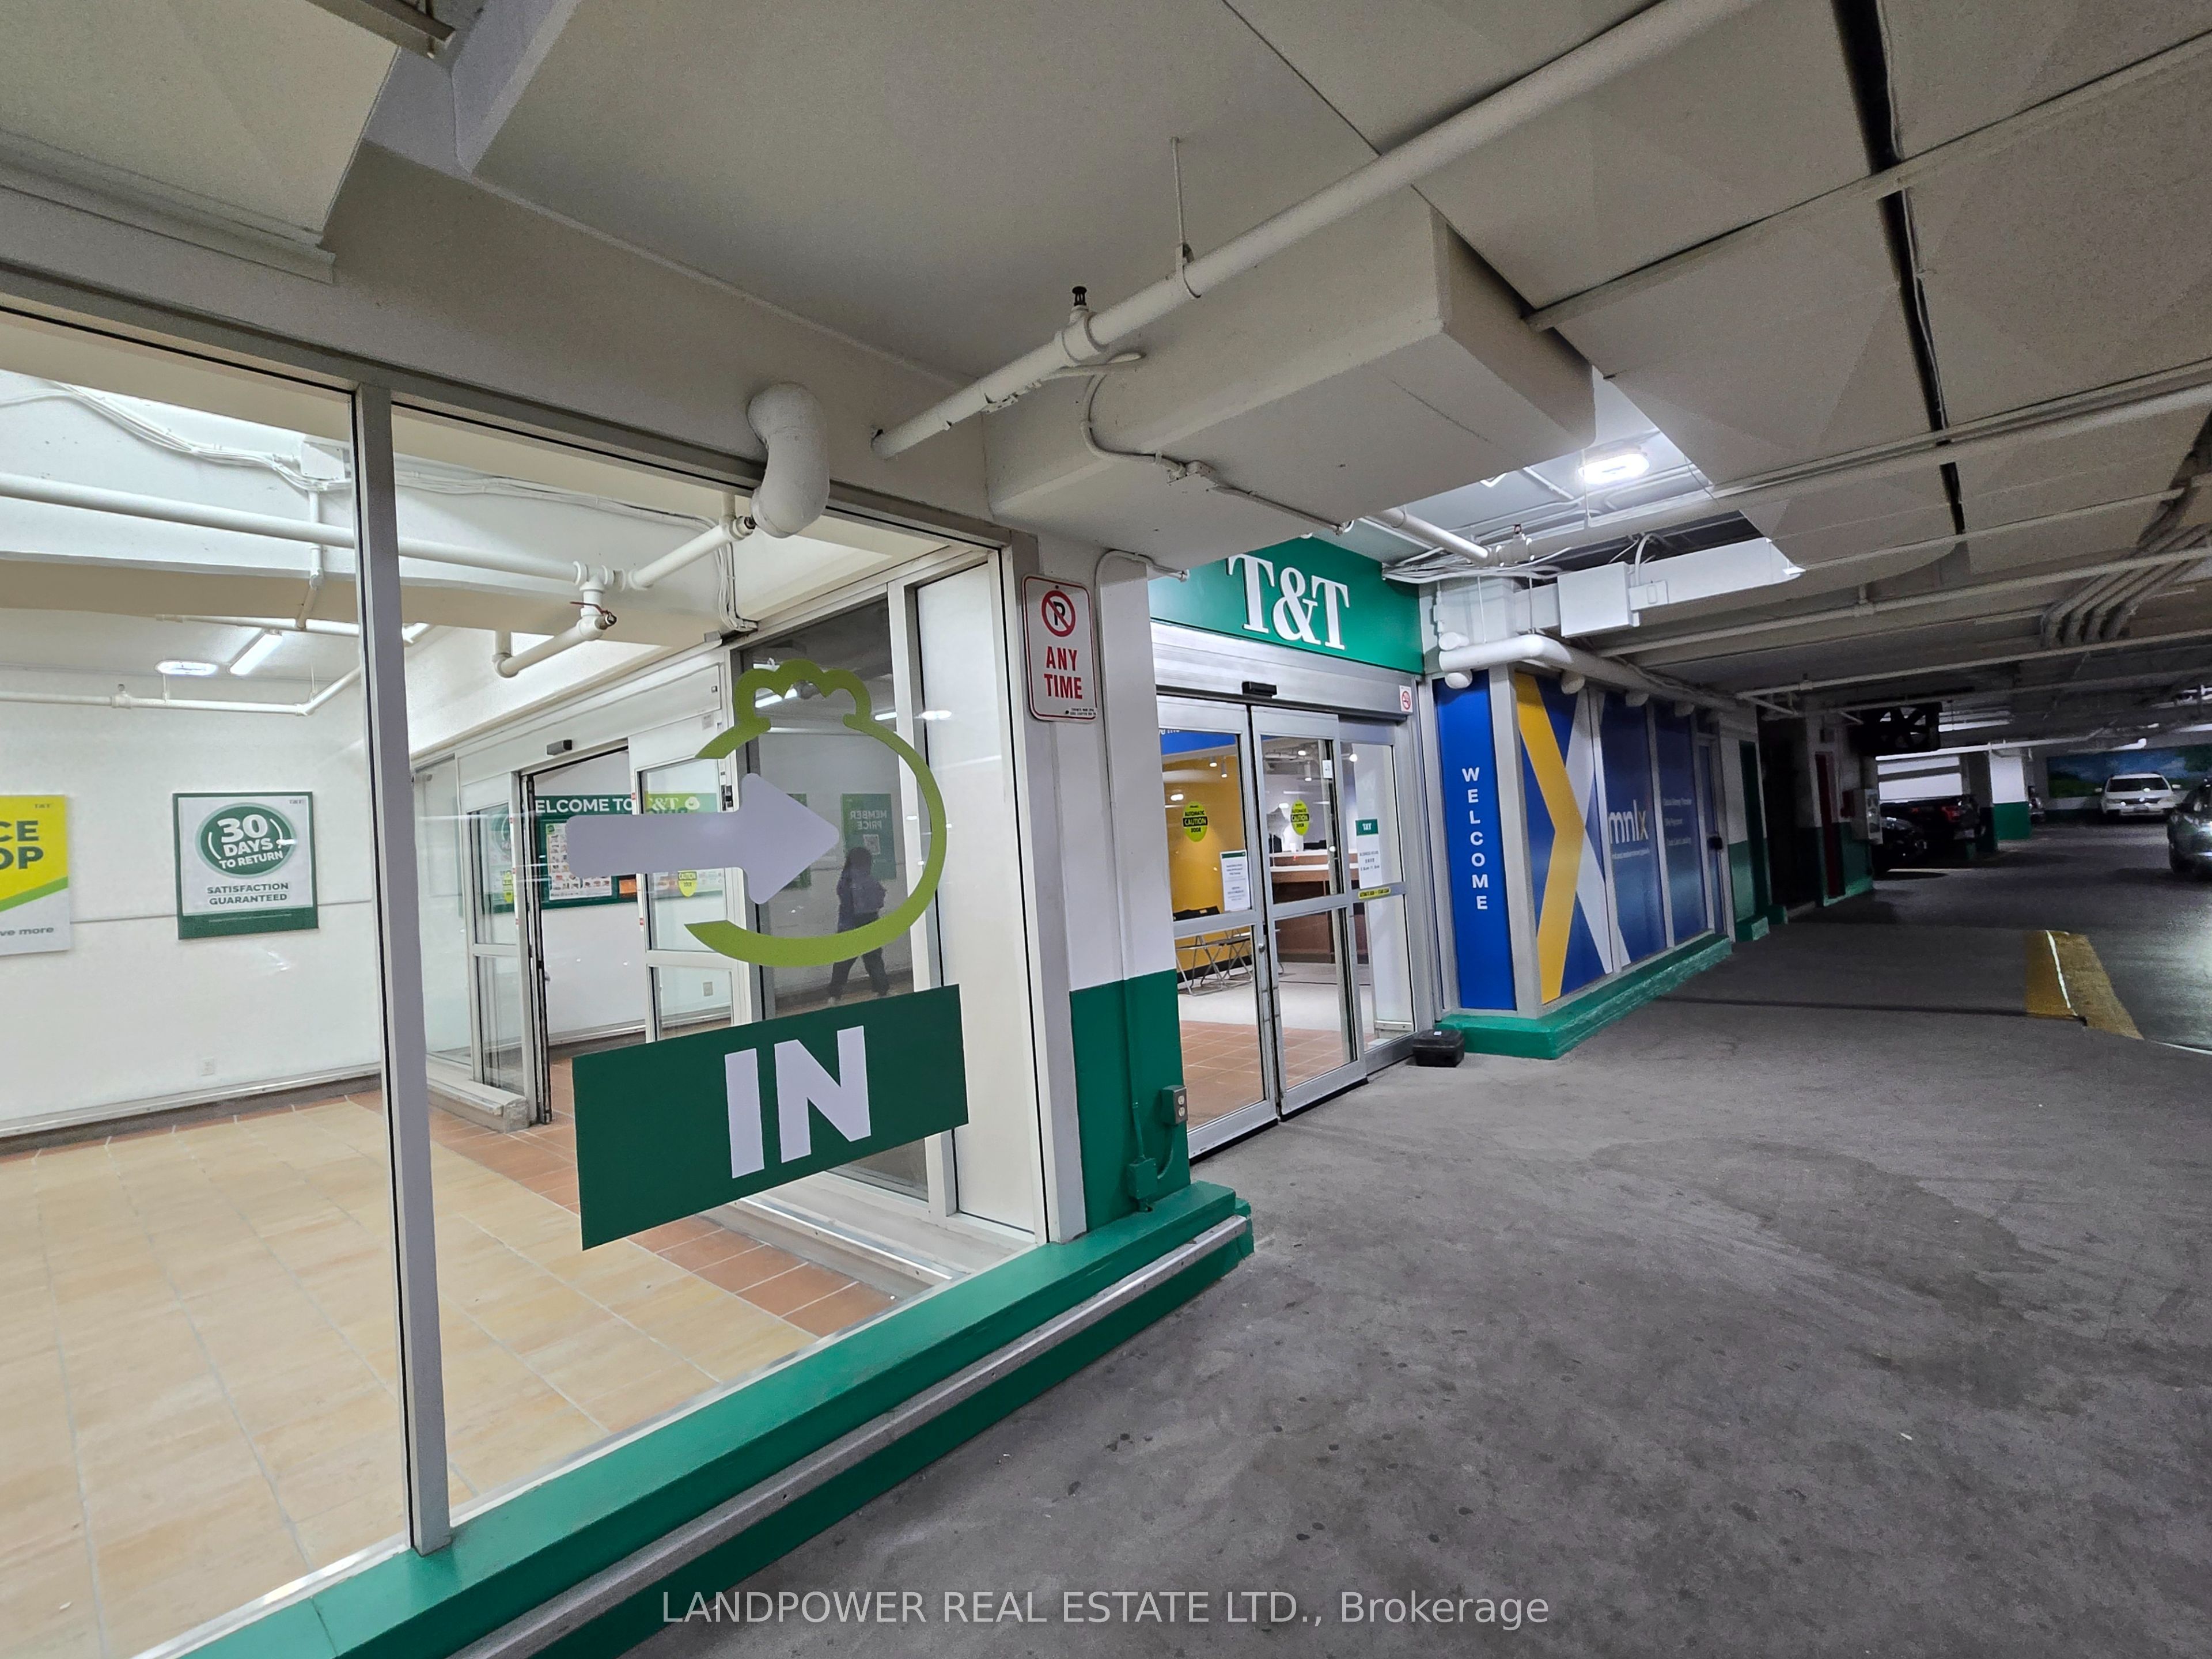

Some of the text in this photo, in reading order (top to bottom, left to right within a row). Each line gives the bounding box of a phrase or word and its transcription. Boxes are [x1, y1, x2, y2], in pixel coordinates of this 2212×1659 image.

[1228, 554, 1350, 650] T&T
[1046, 646, 1077, 672] ANY
[1044, 673, 1083, 699] TIME
[612, 798, 632, 811] TO
[217, 814, 268, 843] 30
[1184, 817, 1206, 826] CAUTION
[223, 838, 273, 857] DAYS
[1461, 767, 1489, 910] WELCOME
[219, 851, 283, 869] TO RETURN
[207, 882, 289, 894] SATISFACTION
[209, 893, 287, 905] GUARANTEED
[19, 926, 54, 935] more
[725, 1025, 871, 1179] IN
